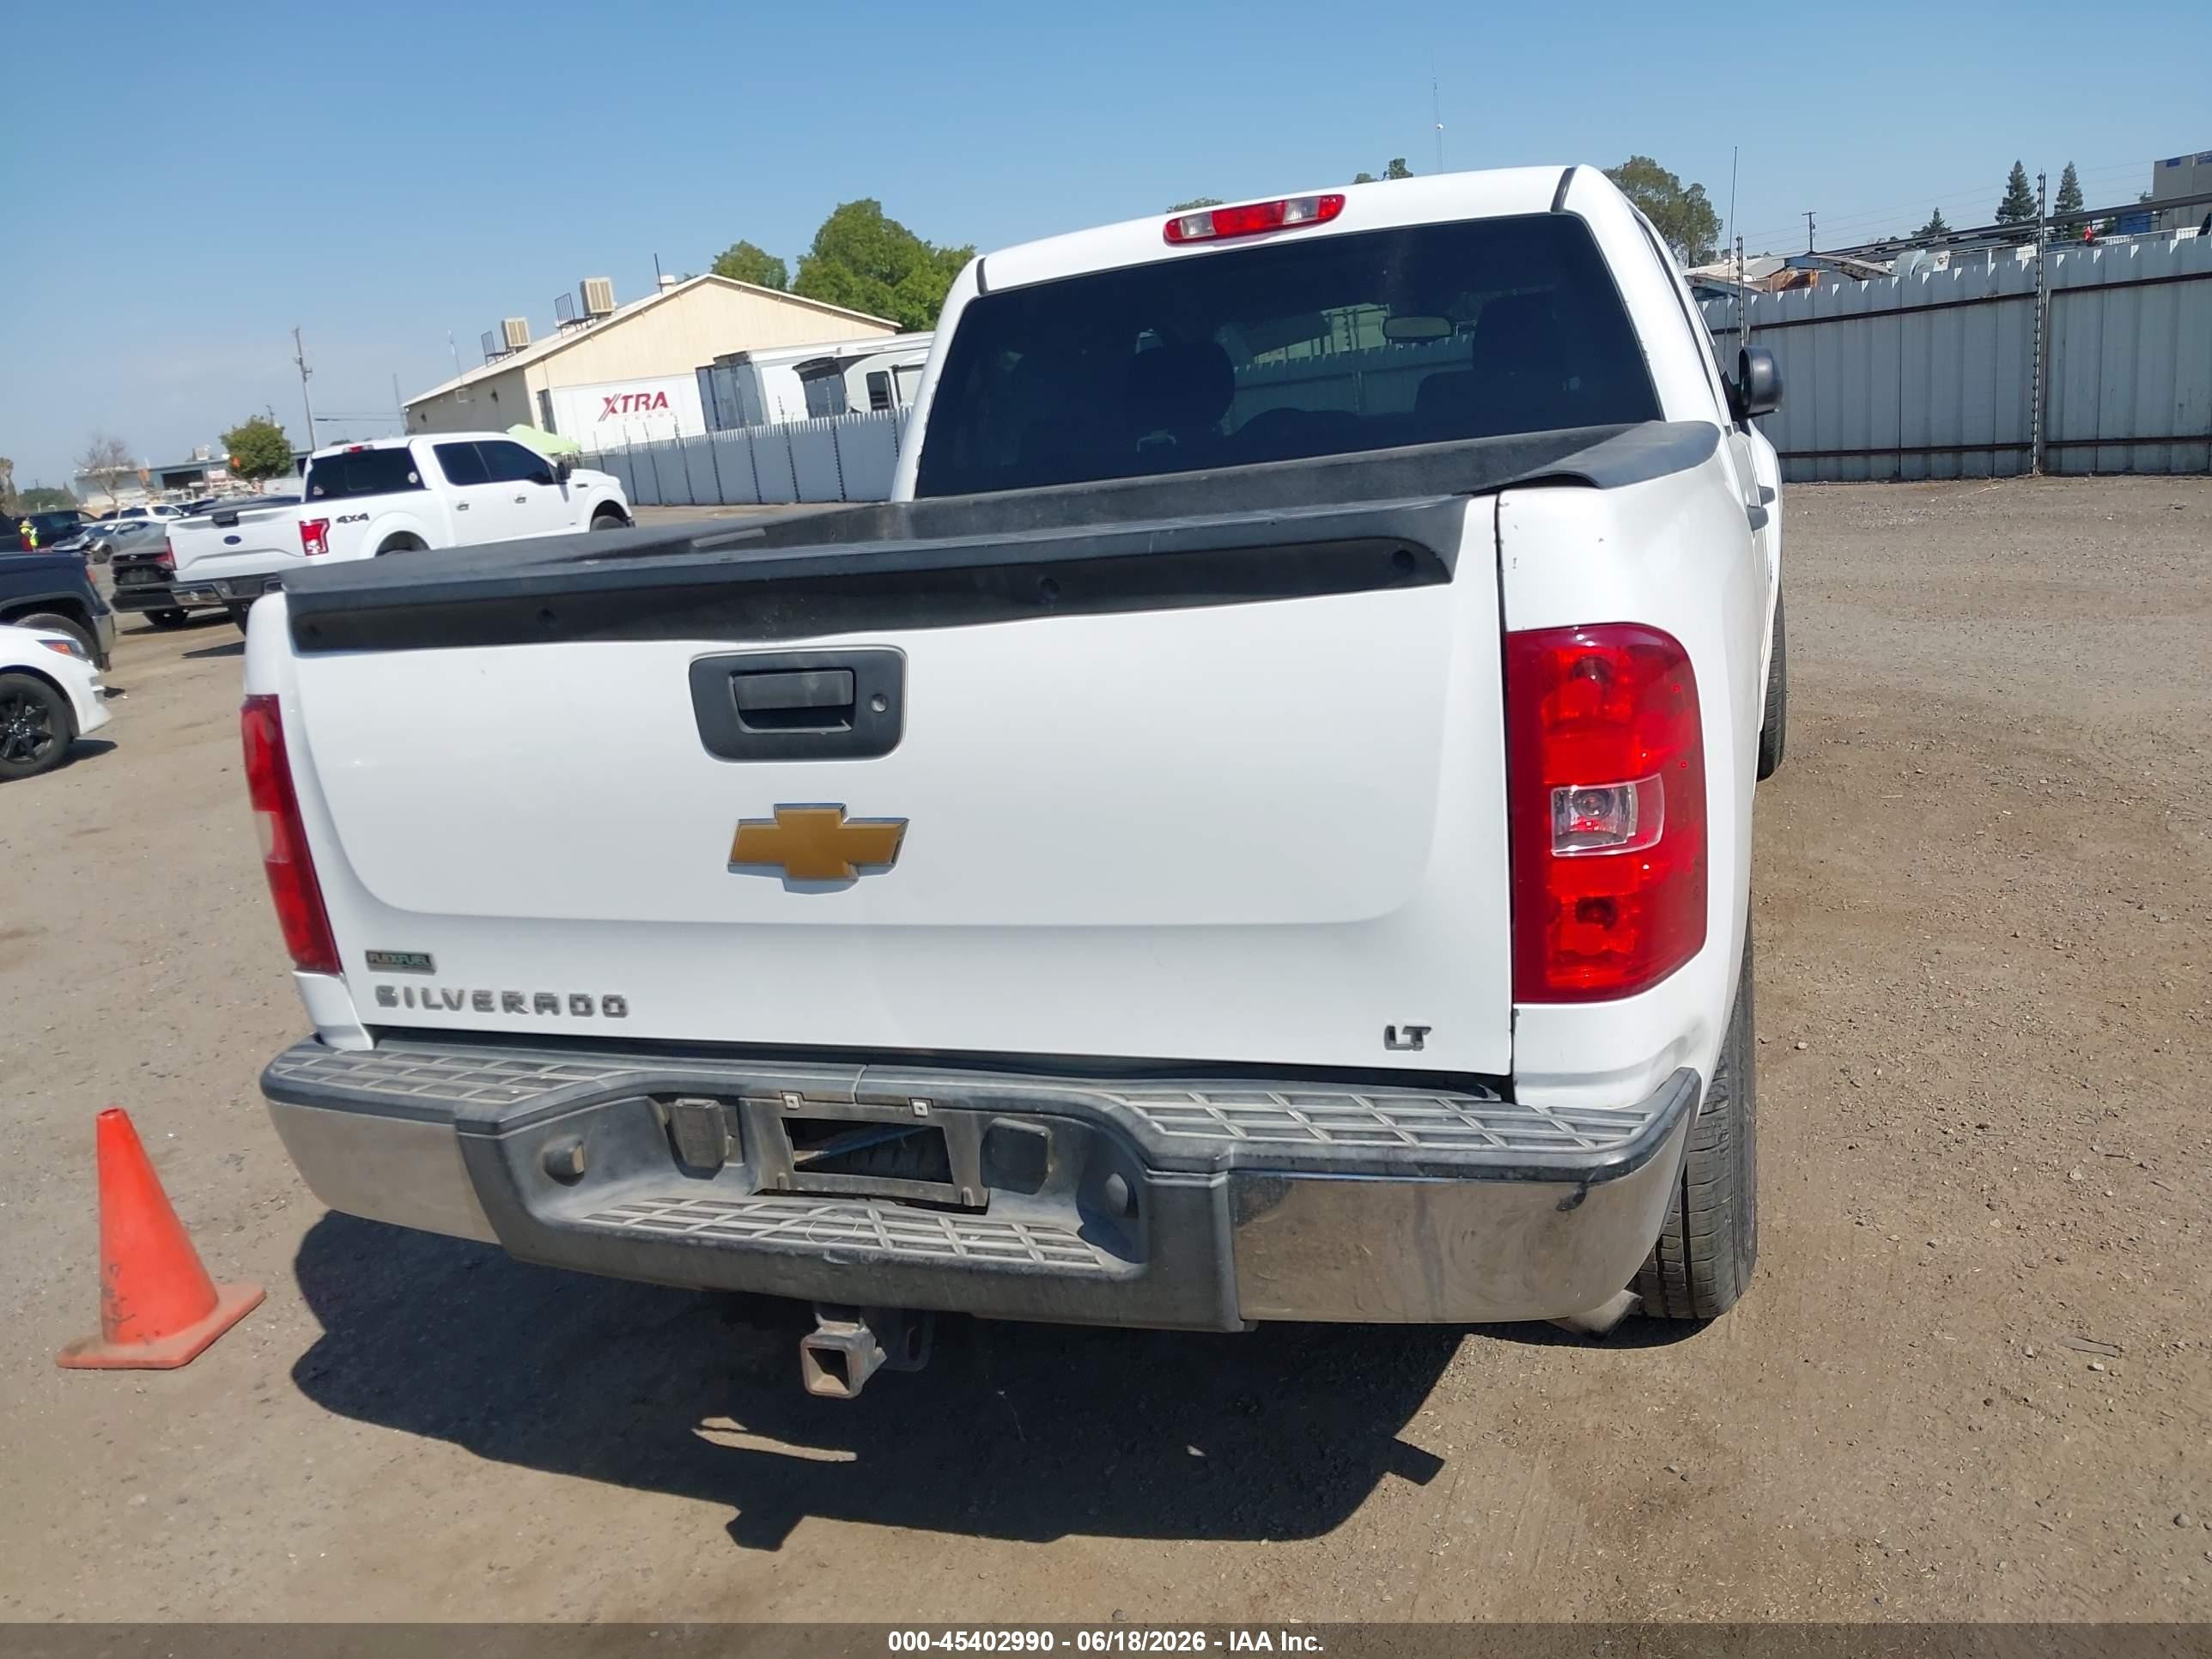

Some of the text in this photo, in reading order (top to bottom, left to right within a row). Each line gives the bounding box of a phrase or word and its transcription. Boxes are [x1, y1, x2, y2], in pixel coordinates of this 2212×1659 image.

[598, 392, 669, 422] XTRA
[375, 985, 628, 1018] SILVERADO
[1383, 1024, 1432, 1051] LT
